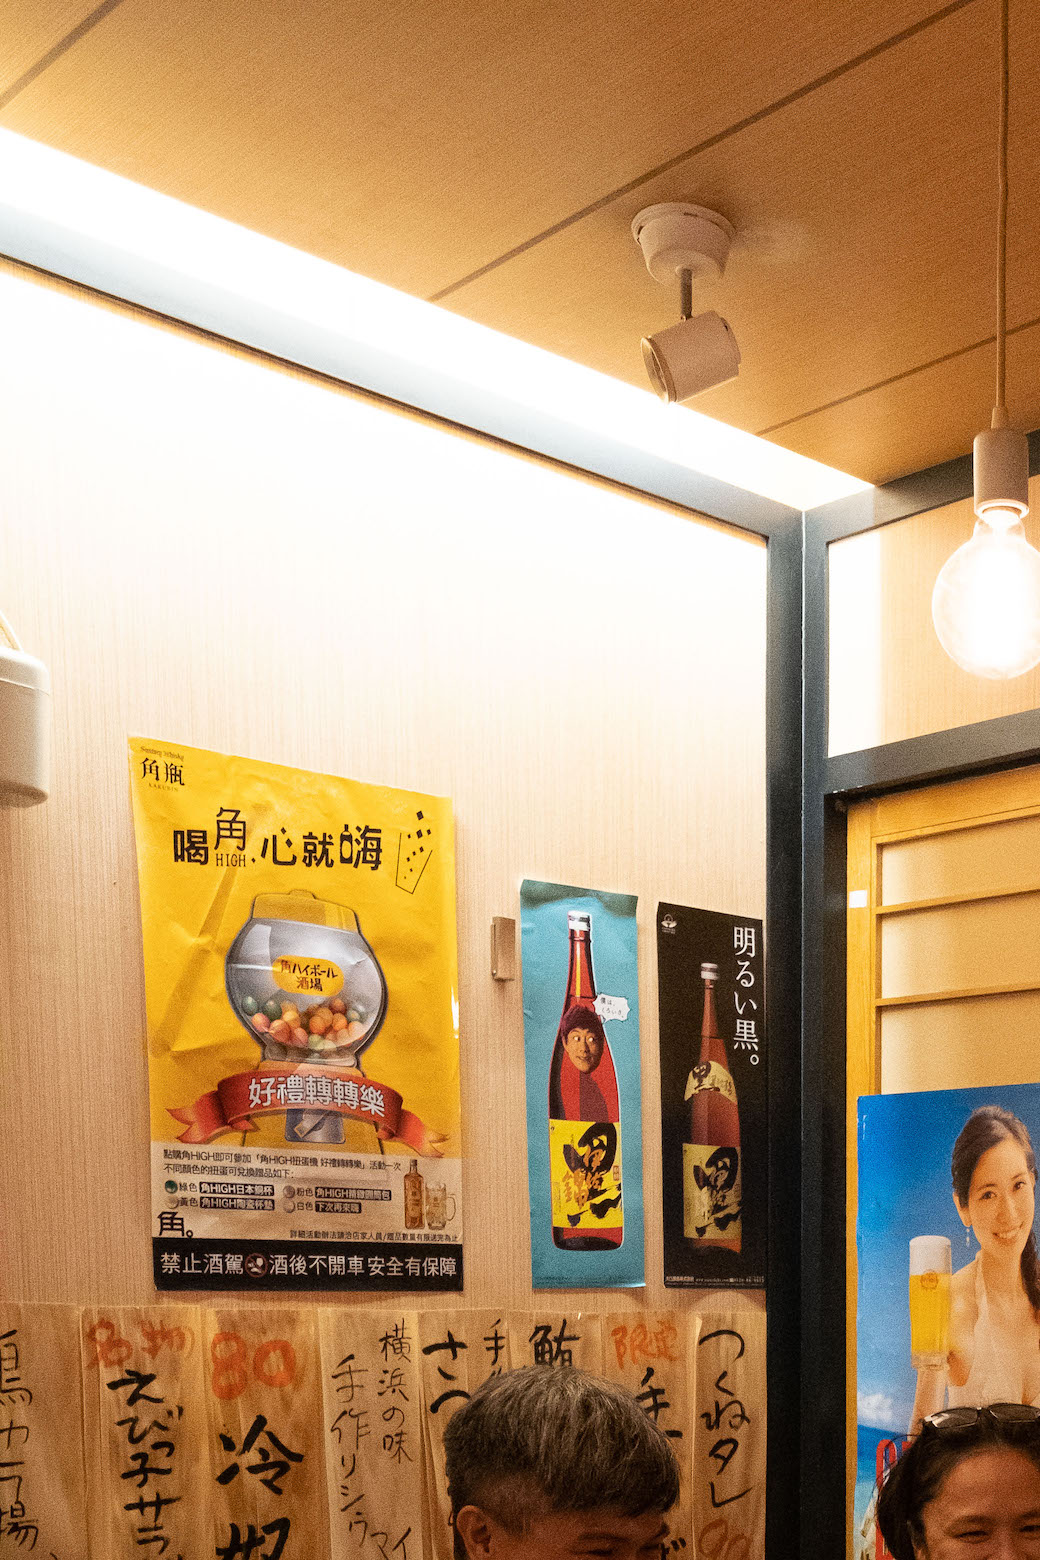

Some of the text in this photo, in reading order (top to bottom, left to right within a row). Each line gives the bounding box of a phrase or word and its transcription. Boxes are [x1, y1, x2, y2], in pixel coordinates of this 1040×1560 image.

[140, 757, 186, 786] 角瓶
[248, 1075, 386, 1118] 好禮轉轉樂
[160, 1253, 244, 1276] 禁止酒駕
[210, 1331, 297, 1401] 80
